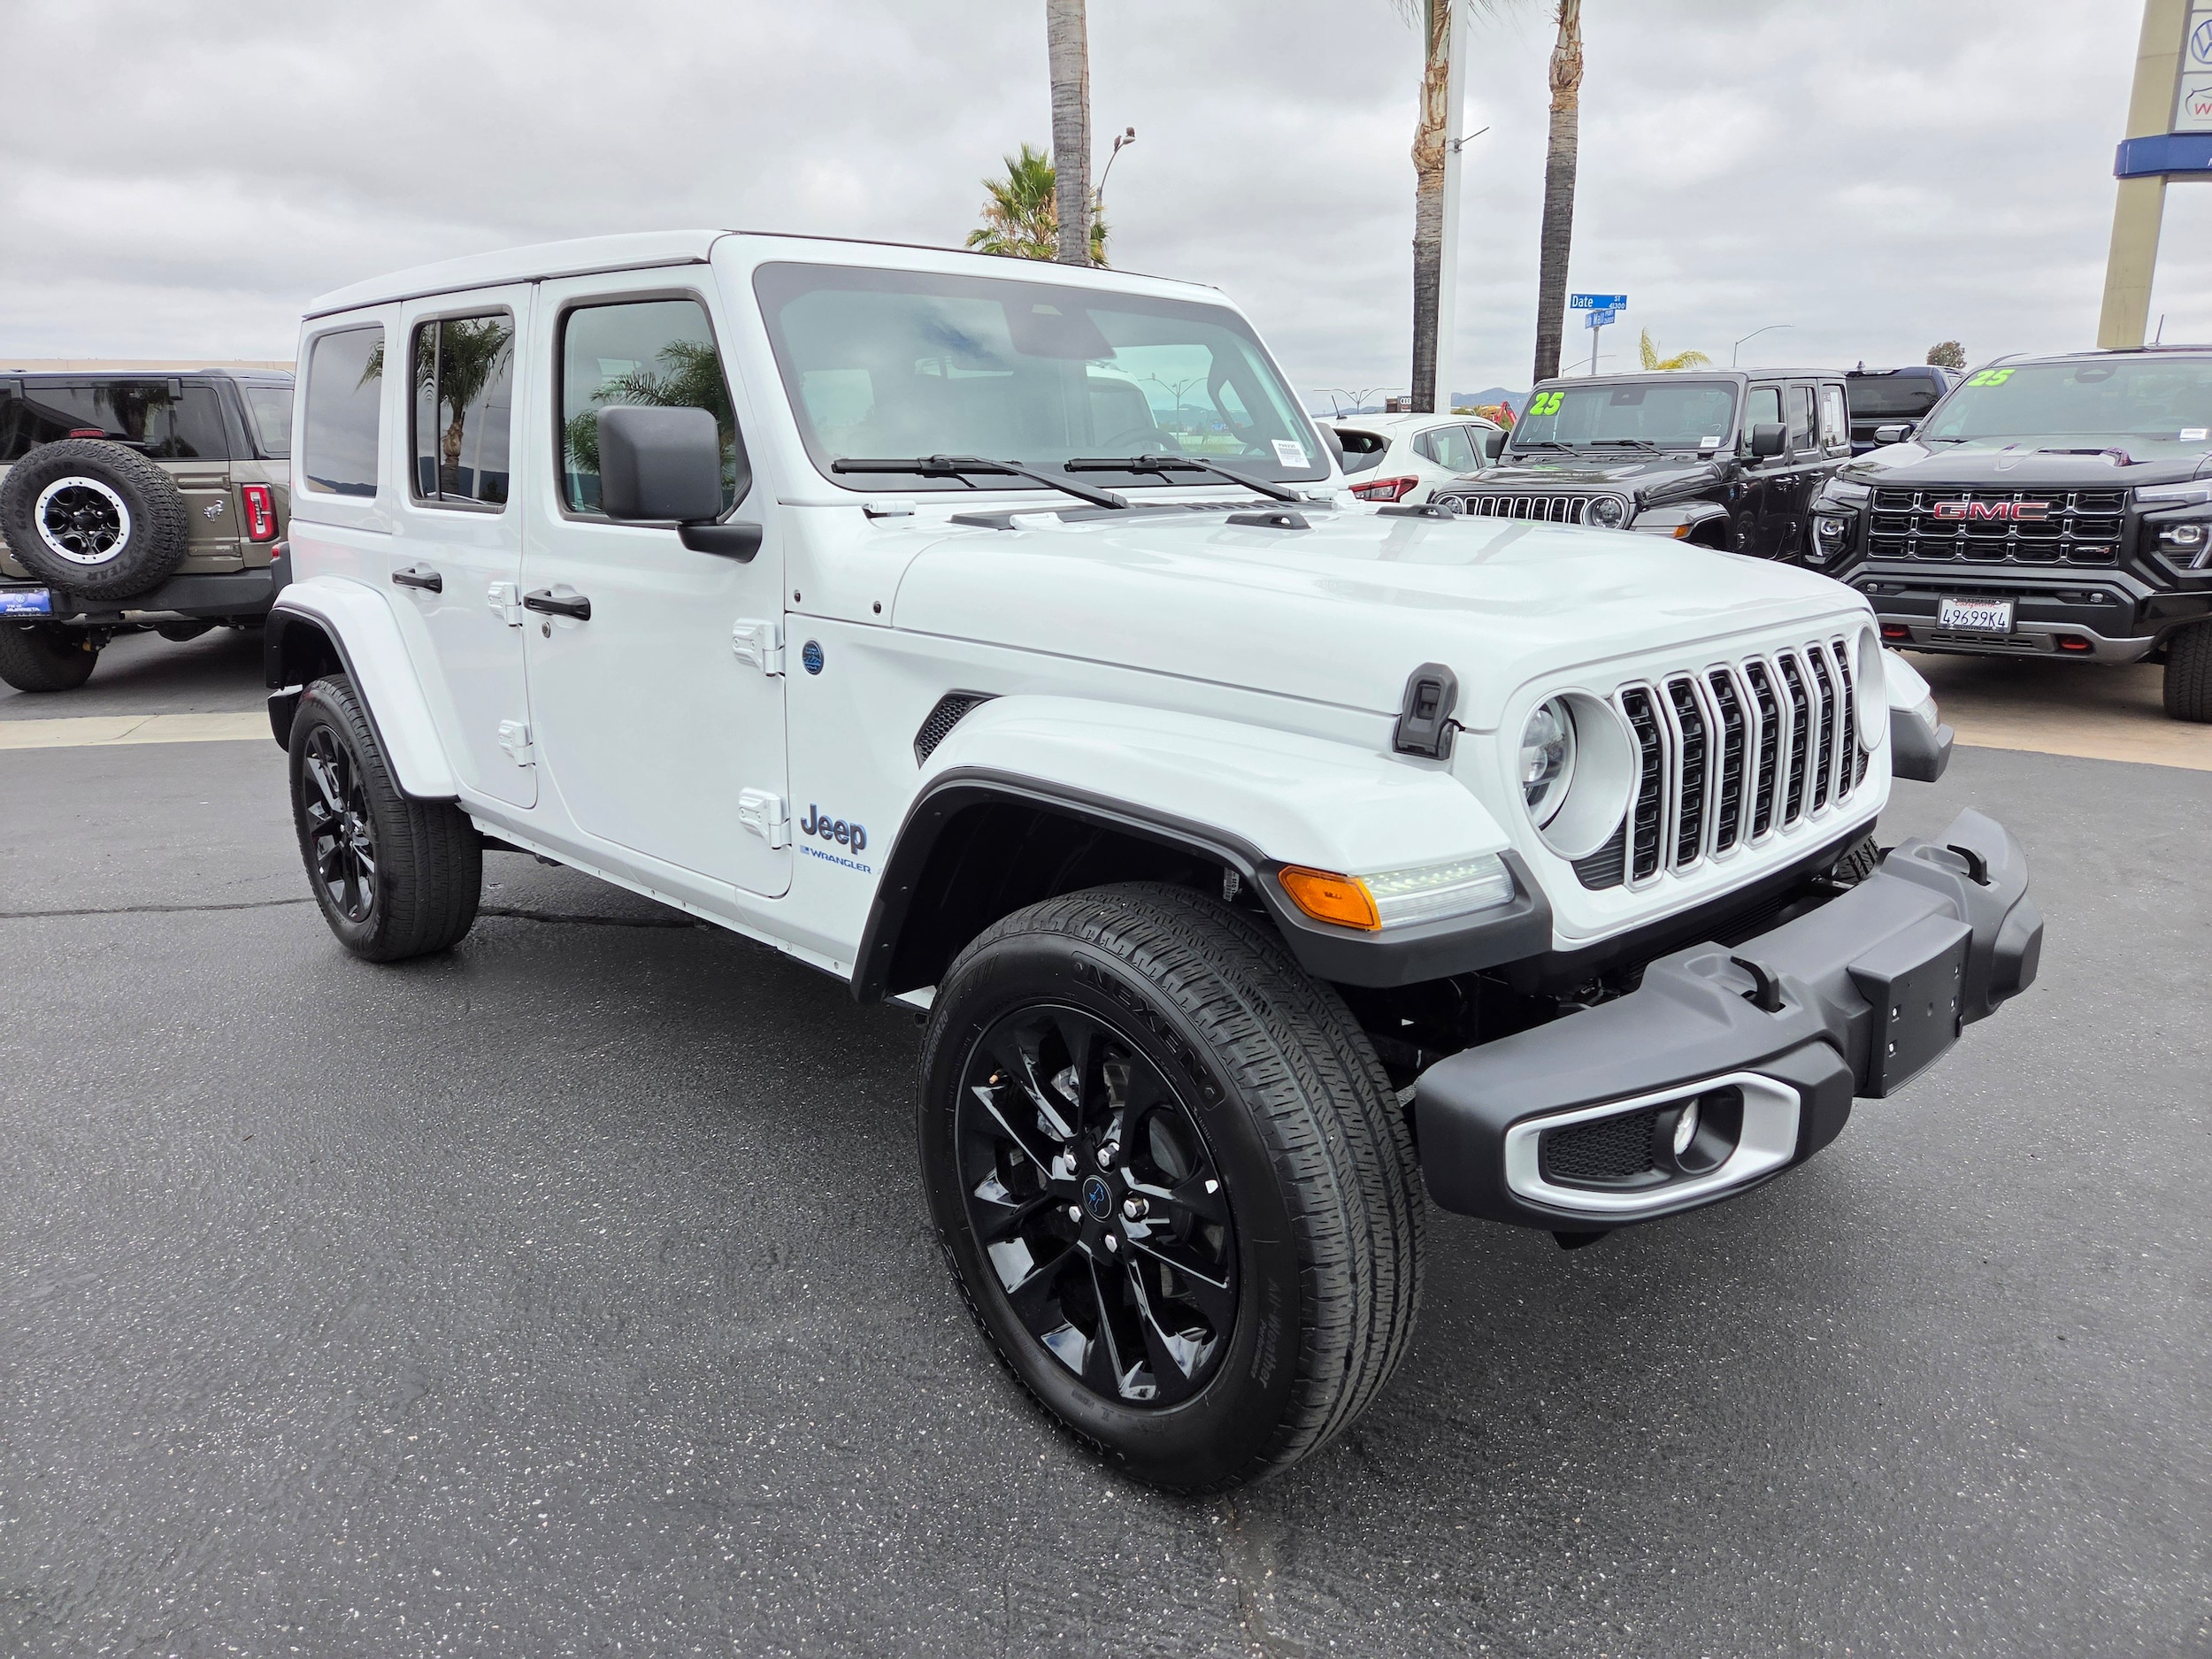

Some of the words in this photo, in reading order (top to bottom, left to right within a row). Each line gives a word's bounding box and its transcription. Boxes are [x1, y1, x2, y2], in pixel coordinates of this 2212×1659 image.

[1571, 295, 1594, 308] Date
[1966, 369, 2016, 387] 25
[1529, 391, 1565, 416] 25
[1932, 501, 2050, 521] GMC
[1942, 609, 2007, 628] 49699K4
[801, 803, 867, 856] Jeep
[810, 848, 872, 874] WRANGLER
[1087, 964, 1209, 1087] NEXEN
